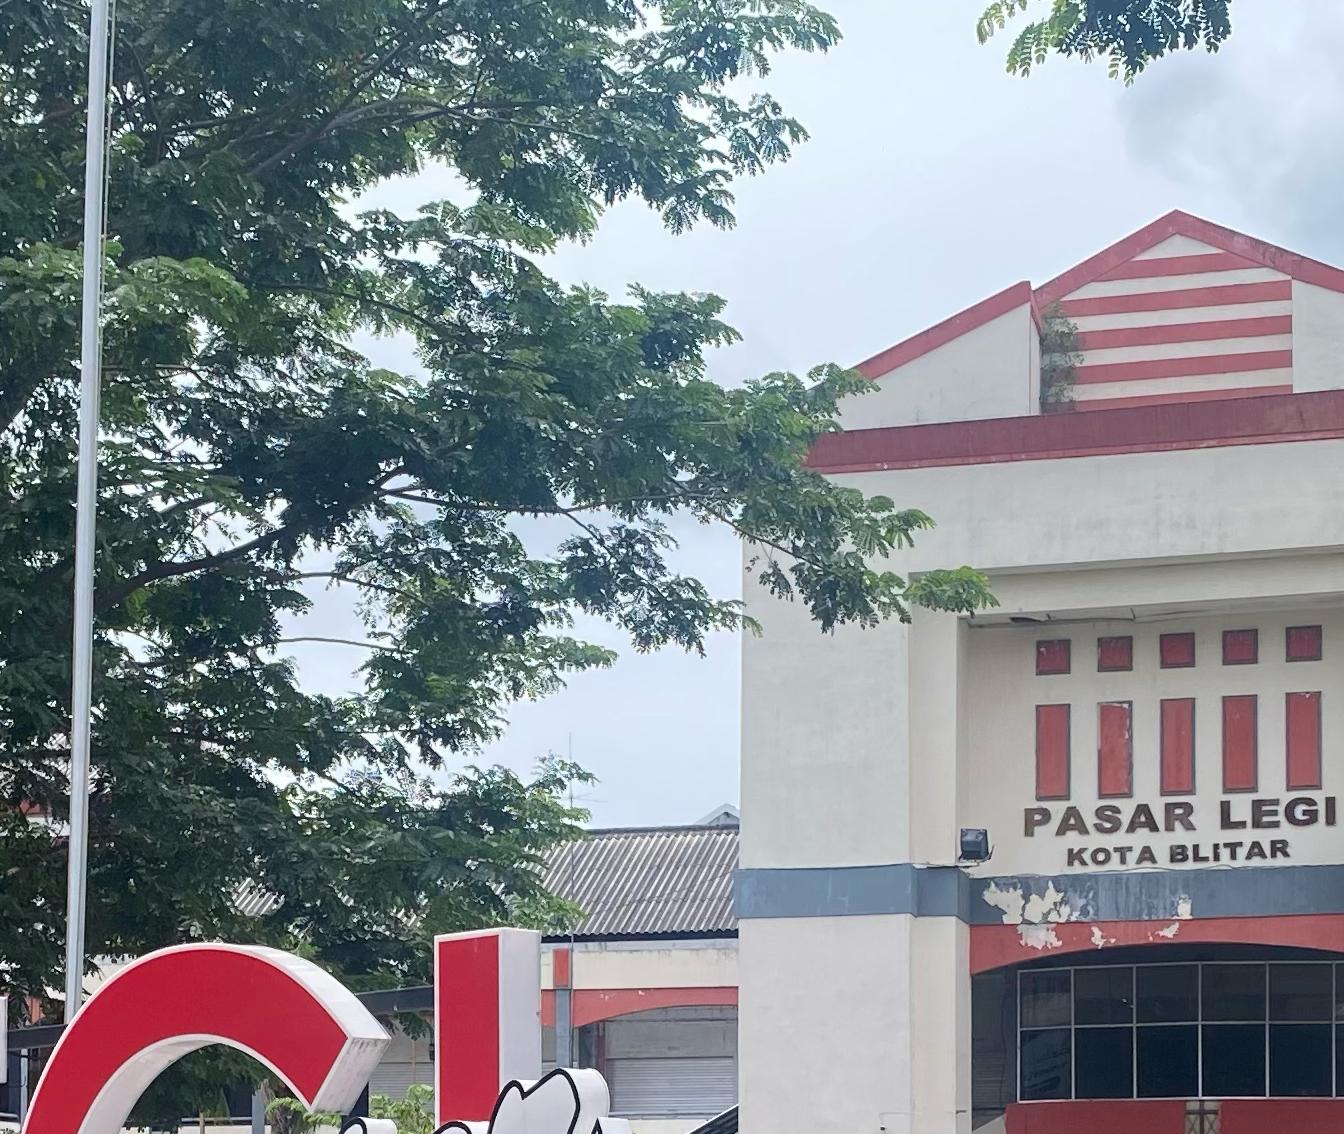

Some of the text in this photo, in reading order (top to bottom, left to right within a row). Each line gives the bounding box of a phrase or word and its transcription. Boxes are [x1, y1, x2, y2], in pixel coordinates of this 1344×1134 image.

[1024, 796, 1337, 838] PASAR LEGI
[1067, 839, 1291, 867] KOTA BLITAR
